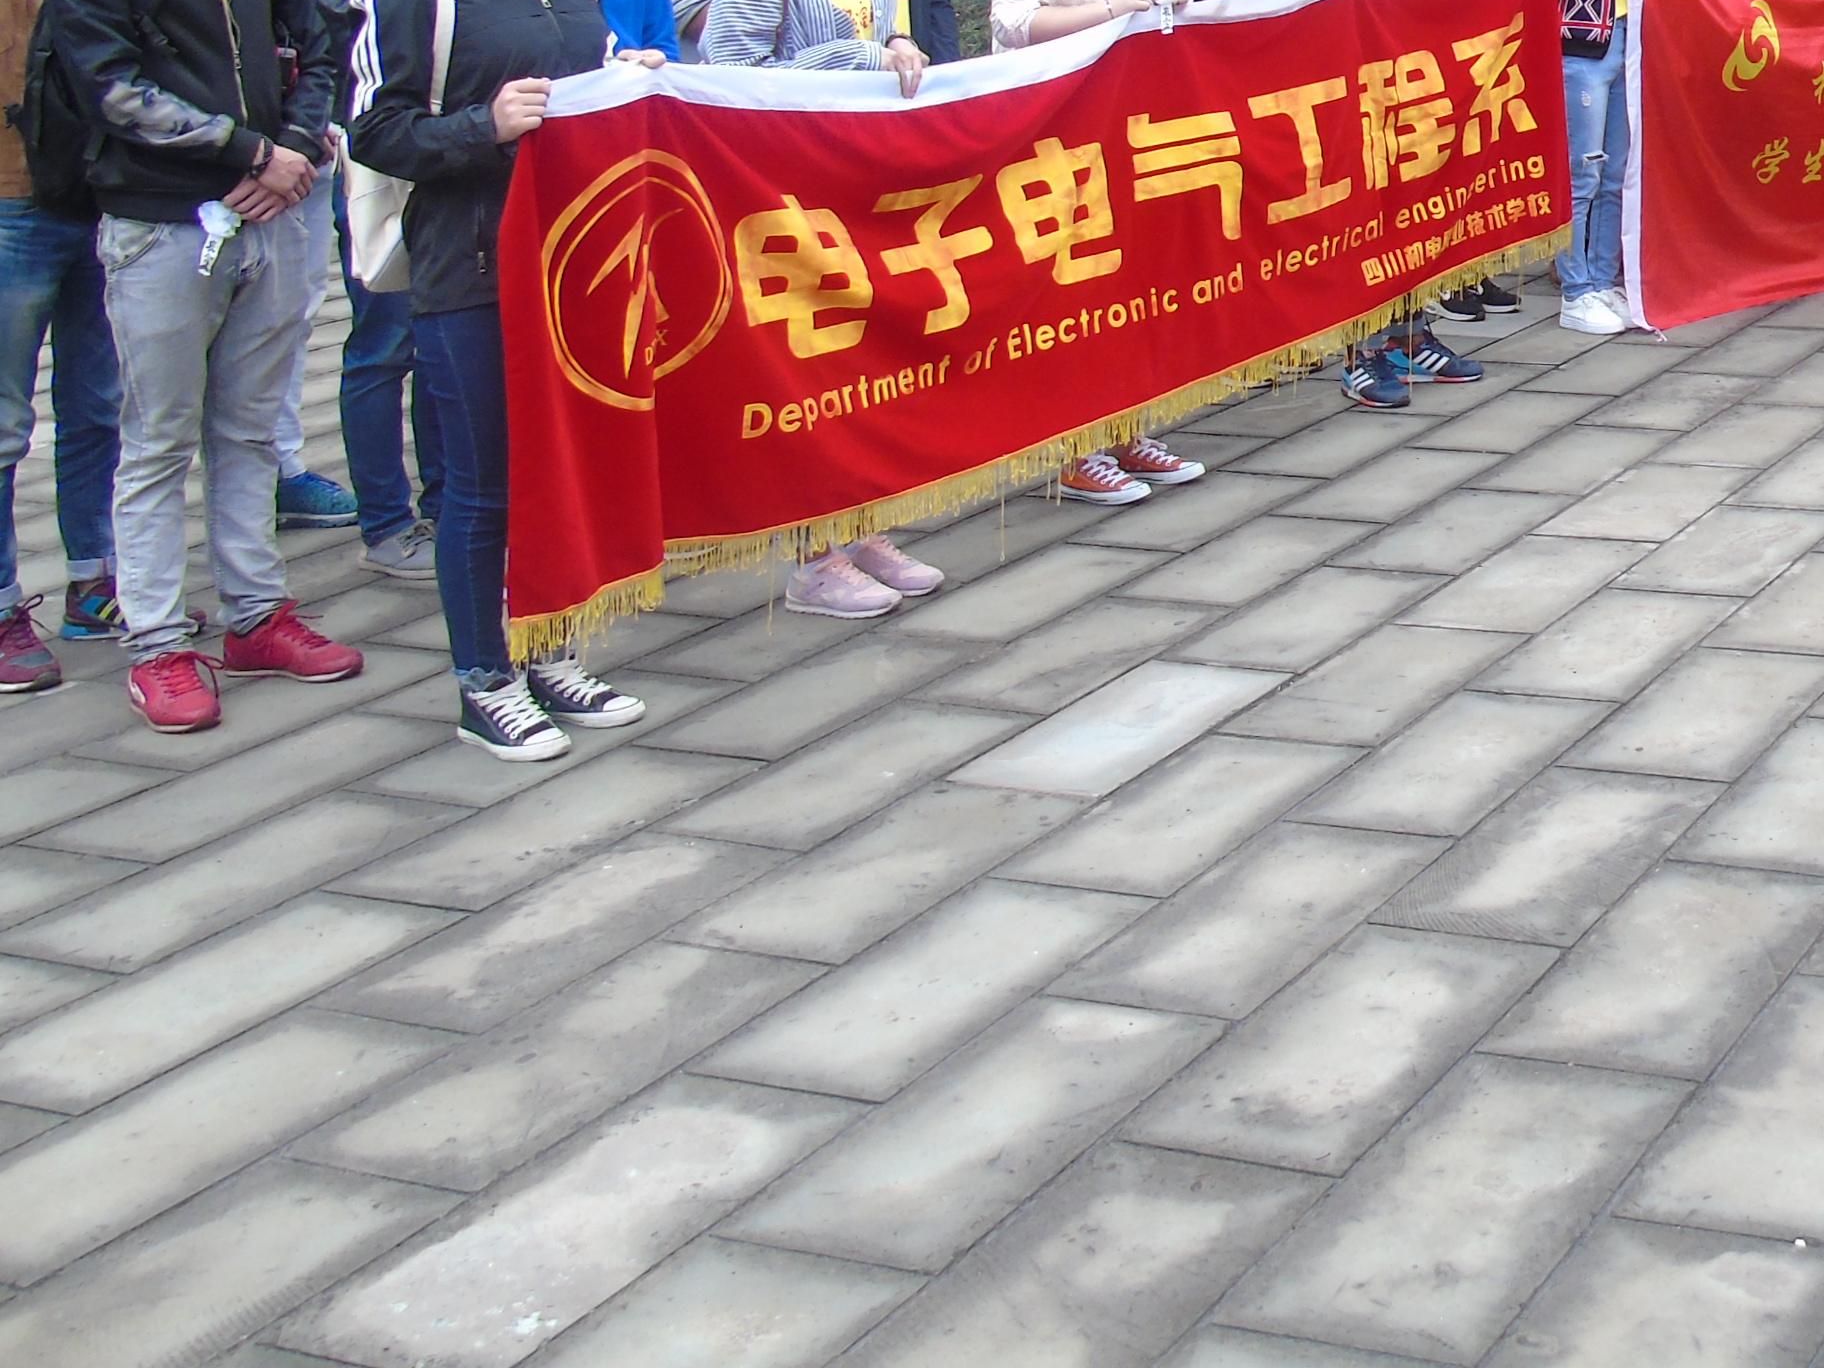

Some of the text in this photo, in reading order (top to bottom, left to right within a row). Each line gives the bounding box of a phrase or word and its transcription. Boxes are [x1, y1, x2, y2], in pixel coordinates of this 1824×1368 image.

[734, 12, 1540, 360] 电子电气工程系
[740, 353, 951, 440] Department
[964, 336, 998, 377] of
[1007, 286, 1179, 360] Electronic
[1192, 261, 1244, 305] and
[1260, 210, 1385, 281] electrical
